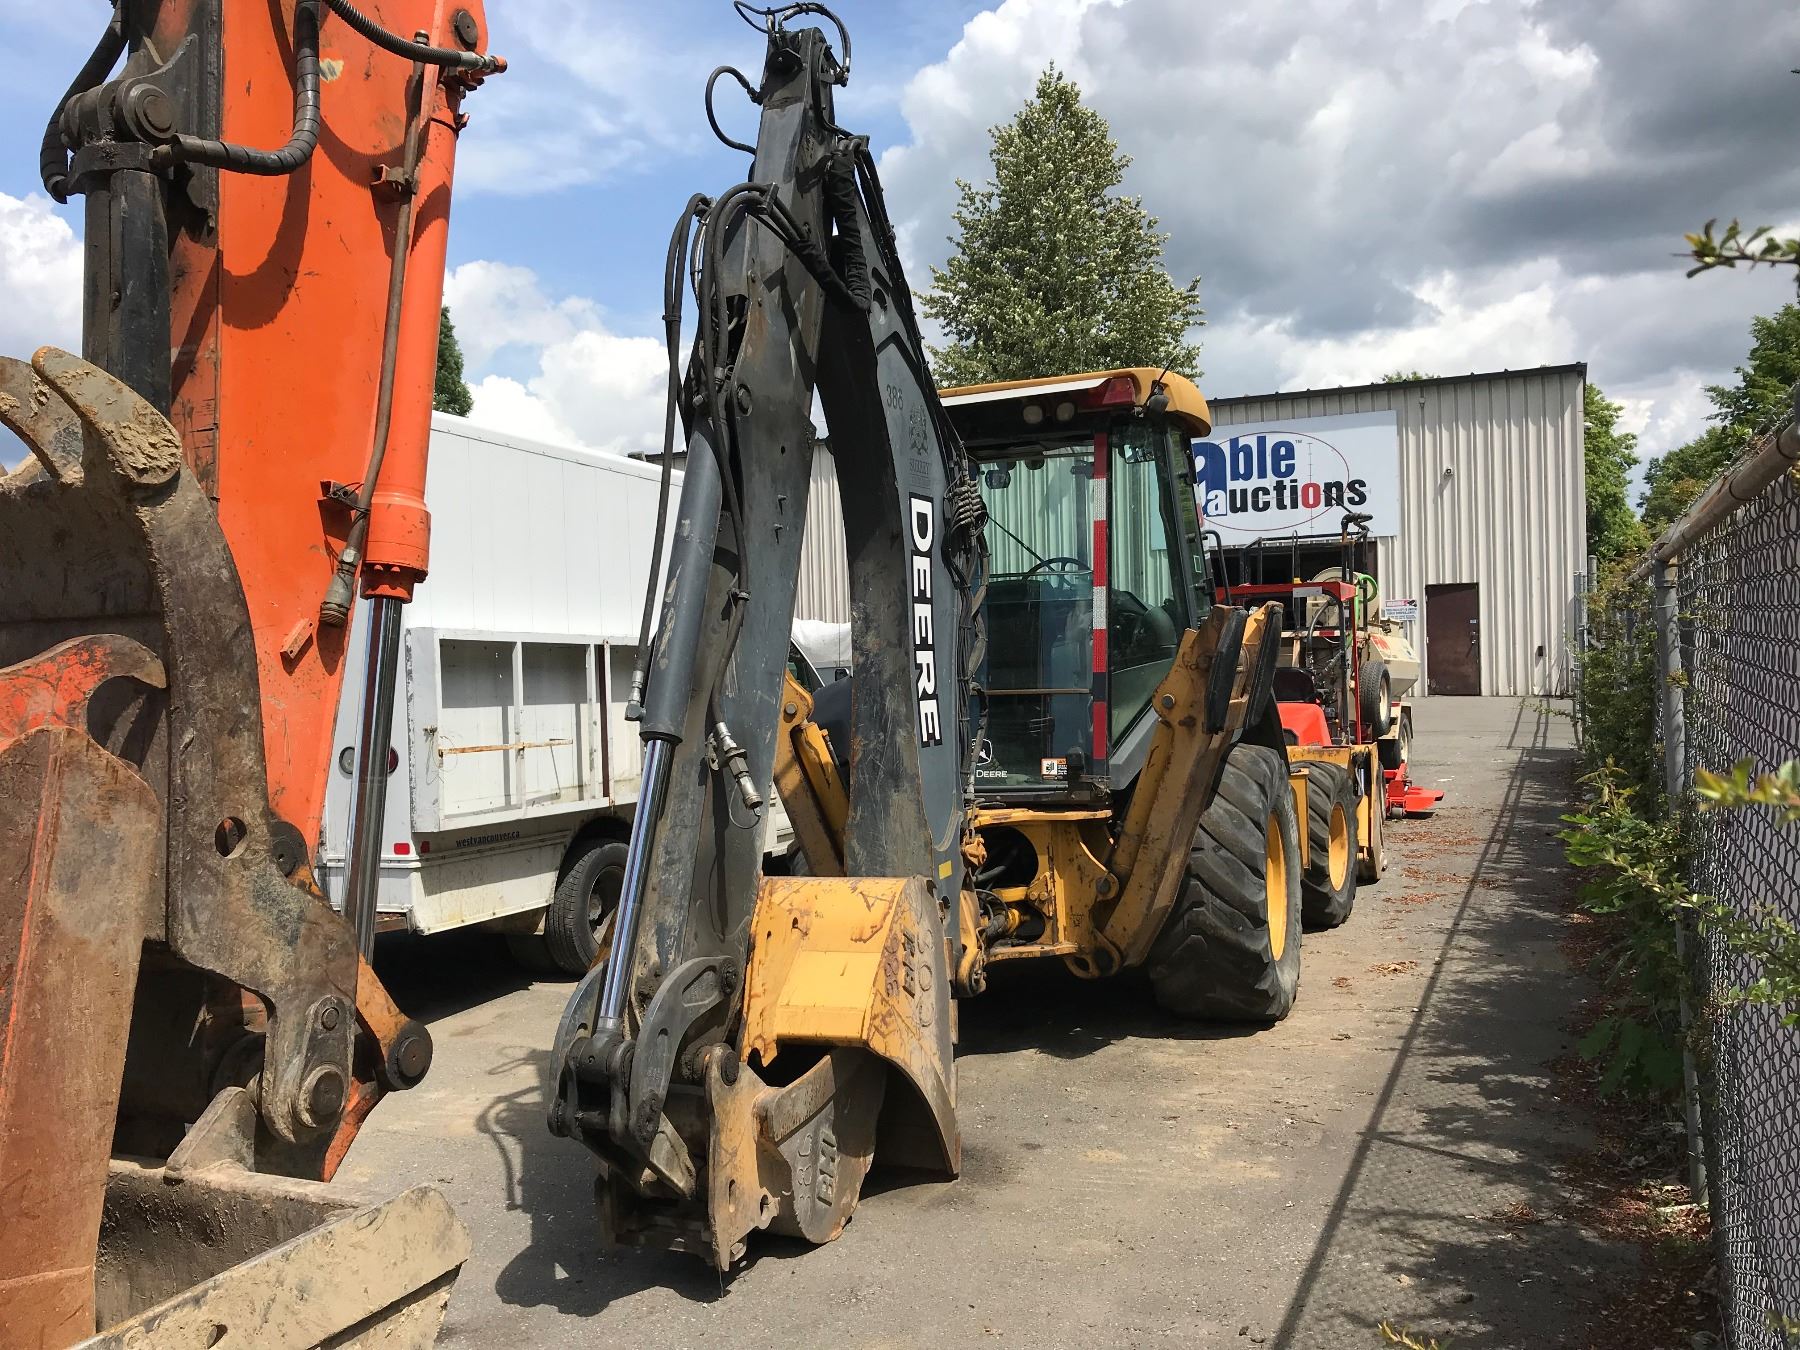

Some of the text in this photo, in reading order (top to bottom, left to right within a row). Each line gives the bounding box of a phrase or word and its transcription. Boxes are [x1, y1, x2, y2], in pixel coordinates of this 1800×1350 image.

[886, 384, 904, 410] 386
[1192, 436, 1296, 516] able
[1207, 479, 1367, 516] auctions
[910, 497, 941, 743] DEERE
[976, 770, 1008, 778] DEERE
[456, 830, 520, 848] westvancouver.ca
